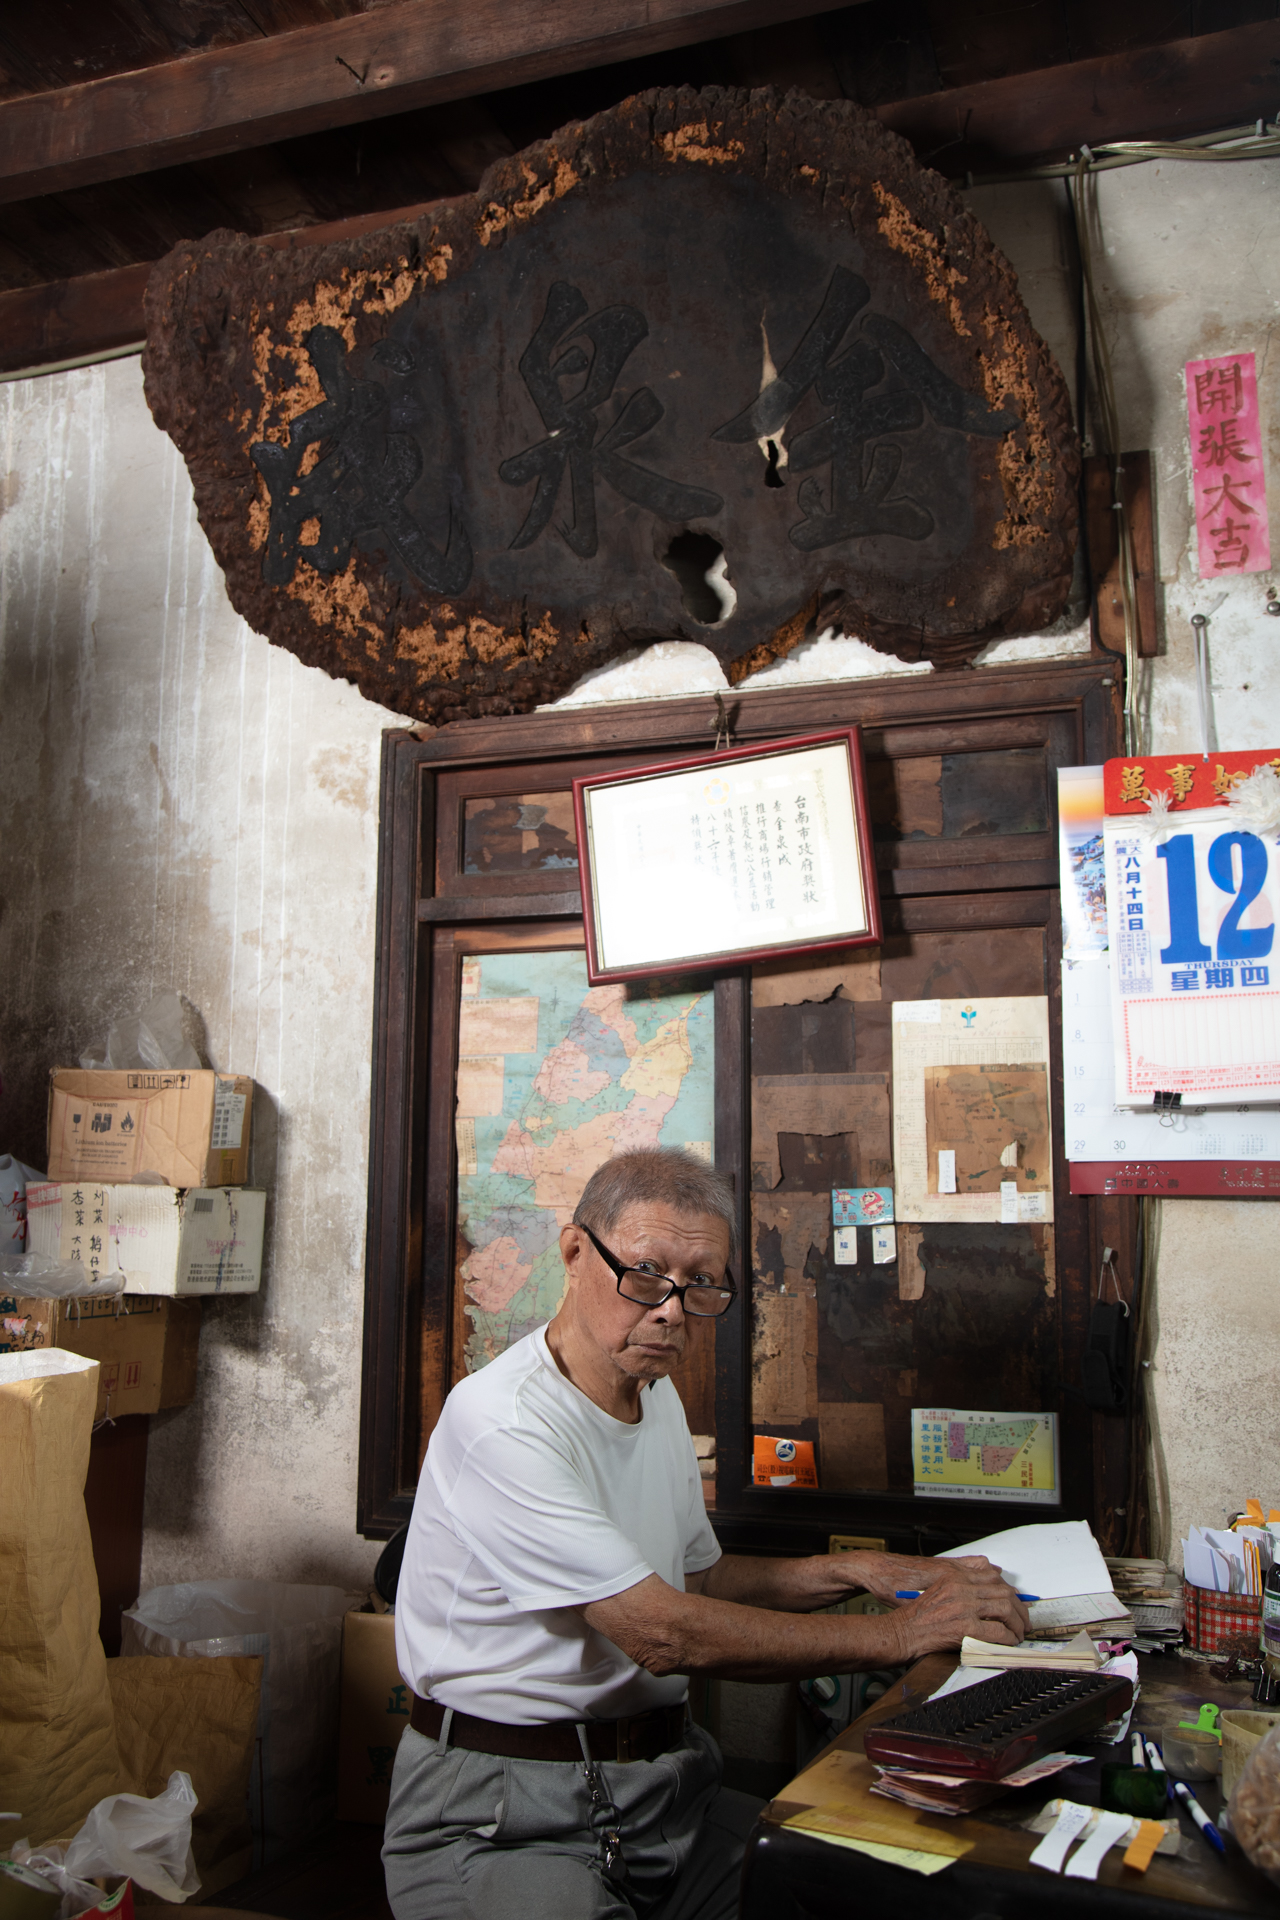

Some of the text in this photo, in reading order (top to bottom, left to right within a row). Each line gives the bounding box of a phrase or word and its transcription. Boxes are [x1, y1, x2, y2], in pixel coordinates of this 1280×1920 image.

[1194, 362, 1260, 570] 開張大吉
[1118, 758, 1280, 803] 萬事如
[794, 795, 819, 903] 台南市政府獎狀
[1125, 856, 1144, 931] 八月十四日
[1156, 831, 1275, 964] 12
[1184, 959, 1255, 970] THURSDAY
[1171, 965, 1269, 991] 星期四
[1074, 1029, 1082, 1039] 8
[1073, 1066, 1085, 1076] 15
[1073, 1103, 1086, 1113] 22
[1236, 1104, 1250, 1113] 26
[1074, 1140, 1086, 1150] 29
[1113, 1140, 1126, 1150] 30
[921, 1423, 932, 1475] 里合併變大
[932, 1423, 944, 1475] 服務更用心
[1020, 1461, 1028, 1487] 三民里
[385, 1684, 410, 1716] 正
